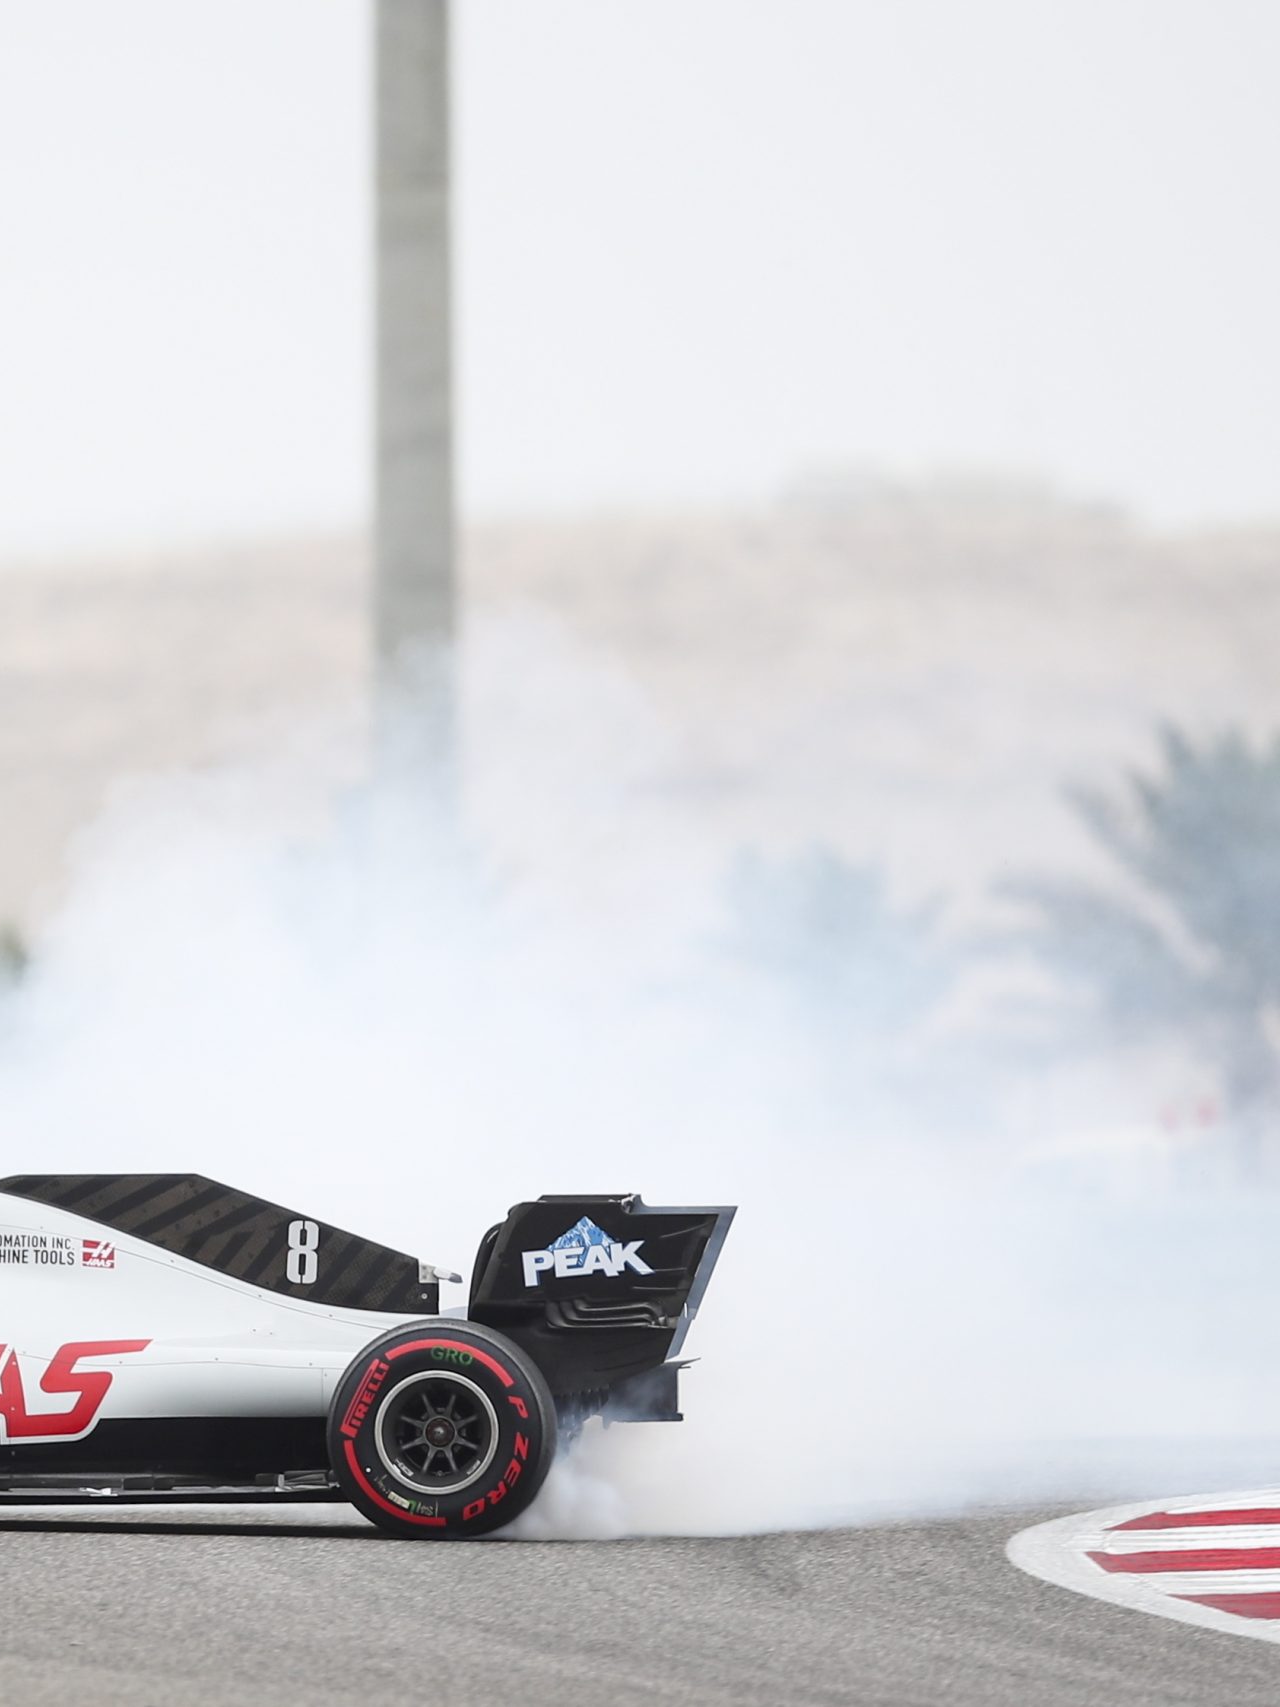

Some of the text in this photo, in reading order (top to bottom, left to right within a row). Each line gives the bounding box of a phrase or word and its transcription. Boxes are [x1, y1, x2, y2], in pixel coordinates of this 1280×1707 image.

[34, 1251, 75, 1265] TOOLS
[52, 1237, 75, 1250] INC.
[286, 1220, 320, 1284] 8
[521, 1240, 655, 1287] PEAK
[340, 1358, 390, 1438] PIRELLI
[463, 1396, 529, 1521] P ZERO
